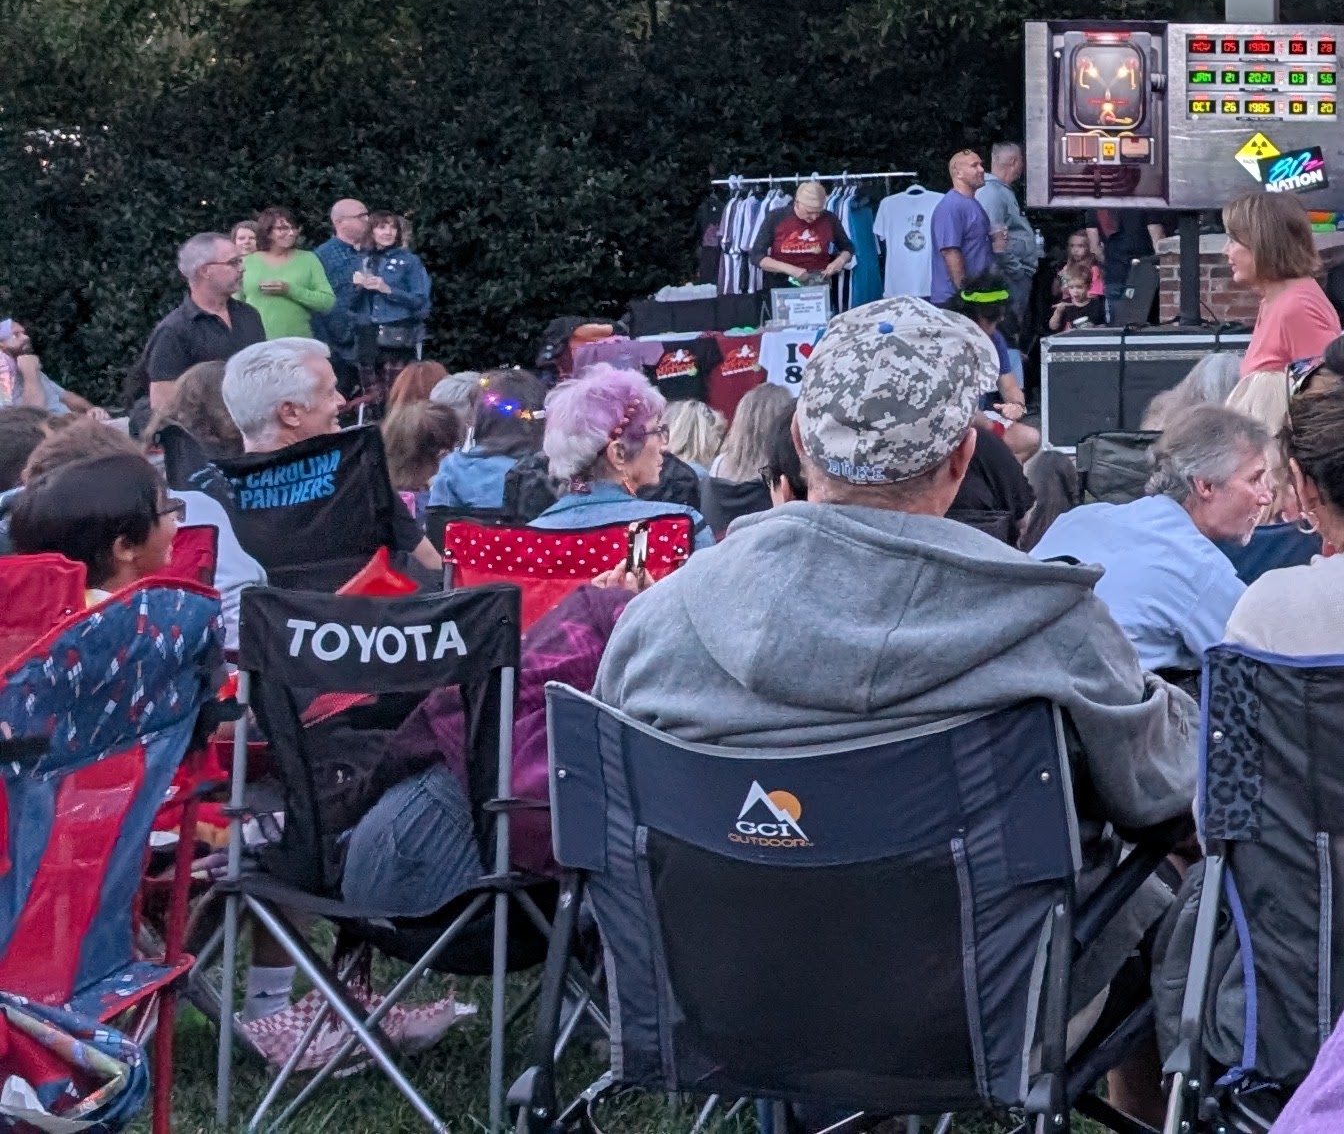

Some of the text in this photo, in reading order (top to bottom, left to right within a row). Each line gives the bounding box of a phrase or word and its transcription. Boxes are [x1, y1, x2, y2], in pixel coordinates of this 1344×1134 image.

[1248, 73, 1271, 83] 2021
[1192, 101, 1211, 112] OCT
[1248, 102, 1271, 113] 1985
[1265, 168, 1324, 193] NATION
[786, 343, 799, 363] I
[246, 449, 341, 489] CAROLINA
[240, 474, 336, 510] PANTHERS
[285, 618, 468, 665] TOYOTA
[735, 820, 792, 837] GCI
[727, 831, 806, 848] OUTDOOR
